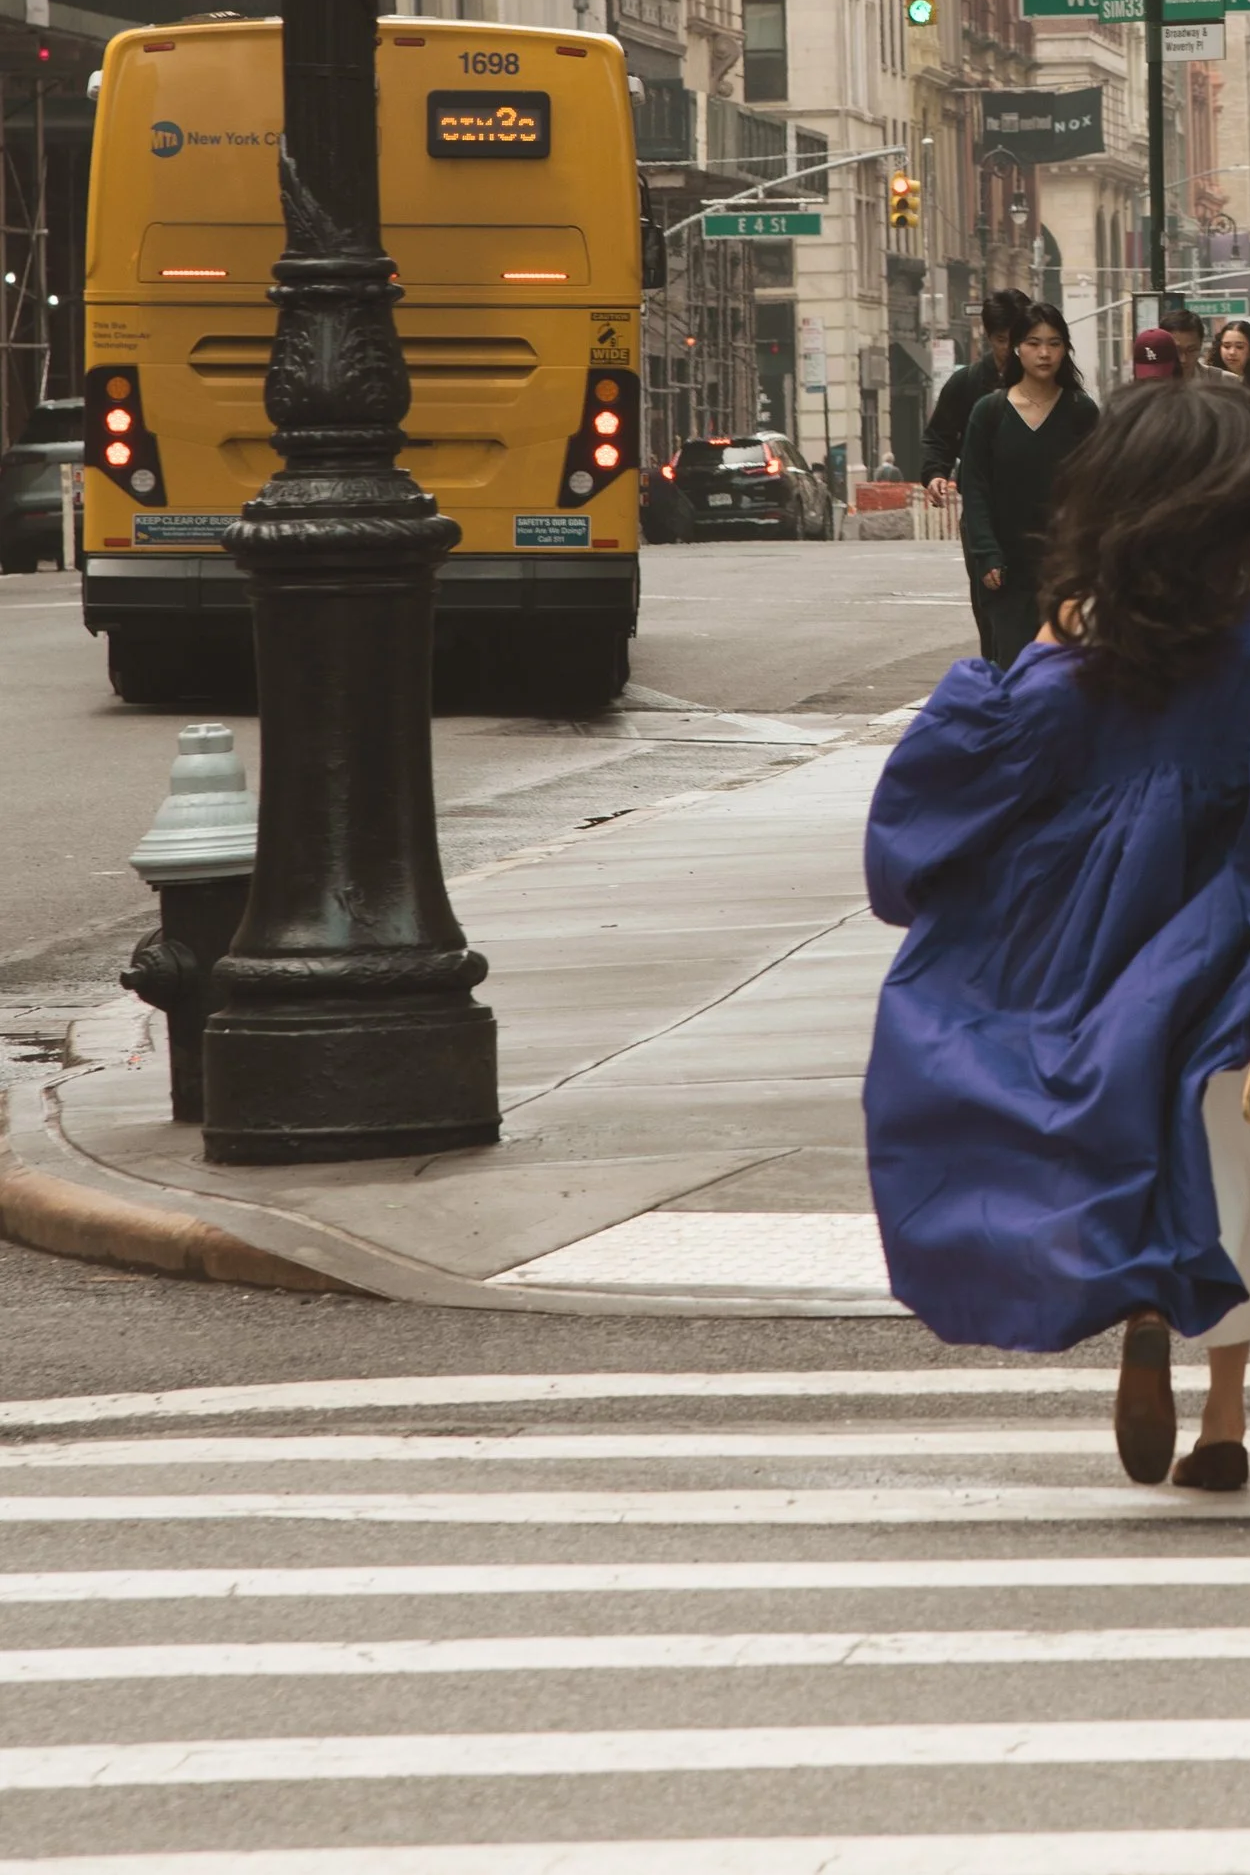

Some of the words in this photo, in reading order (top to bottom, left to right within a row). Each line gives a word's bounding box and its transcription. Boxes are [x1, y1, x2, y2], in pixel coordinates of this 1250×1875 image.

[1165, 28, 1200, 39] Broadway
[1165, 41, 1194, 53] Waverly
[459, 51, 520, 75] 1698
[1054, 114, 1092, 133] NOX
[187, 132, 222, 146] New
[225, 132, 261, 146] York
[264, 132, 281, 146] Ci
[738, 217, 747, 233] E
[753, 217, 765, 233] 4
[770, 216, 787, 233] St
[592, 349, 628, 359] WIDE
[135, 516, 161, 525] KEEP
[162, 516, 194, 525] CLEAR
[195, 516, 208, 525] OF
[210, 516, 242, 525] BUSES
[517, 518, 551, 526] SAFETY'S
[552, 518, 567, 526] OUR
[568, 518, 587, 526] GOAL
[561, 527, 587, 536] Doing?
